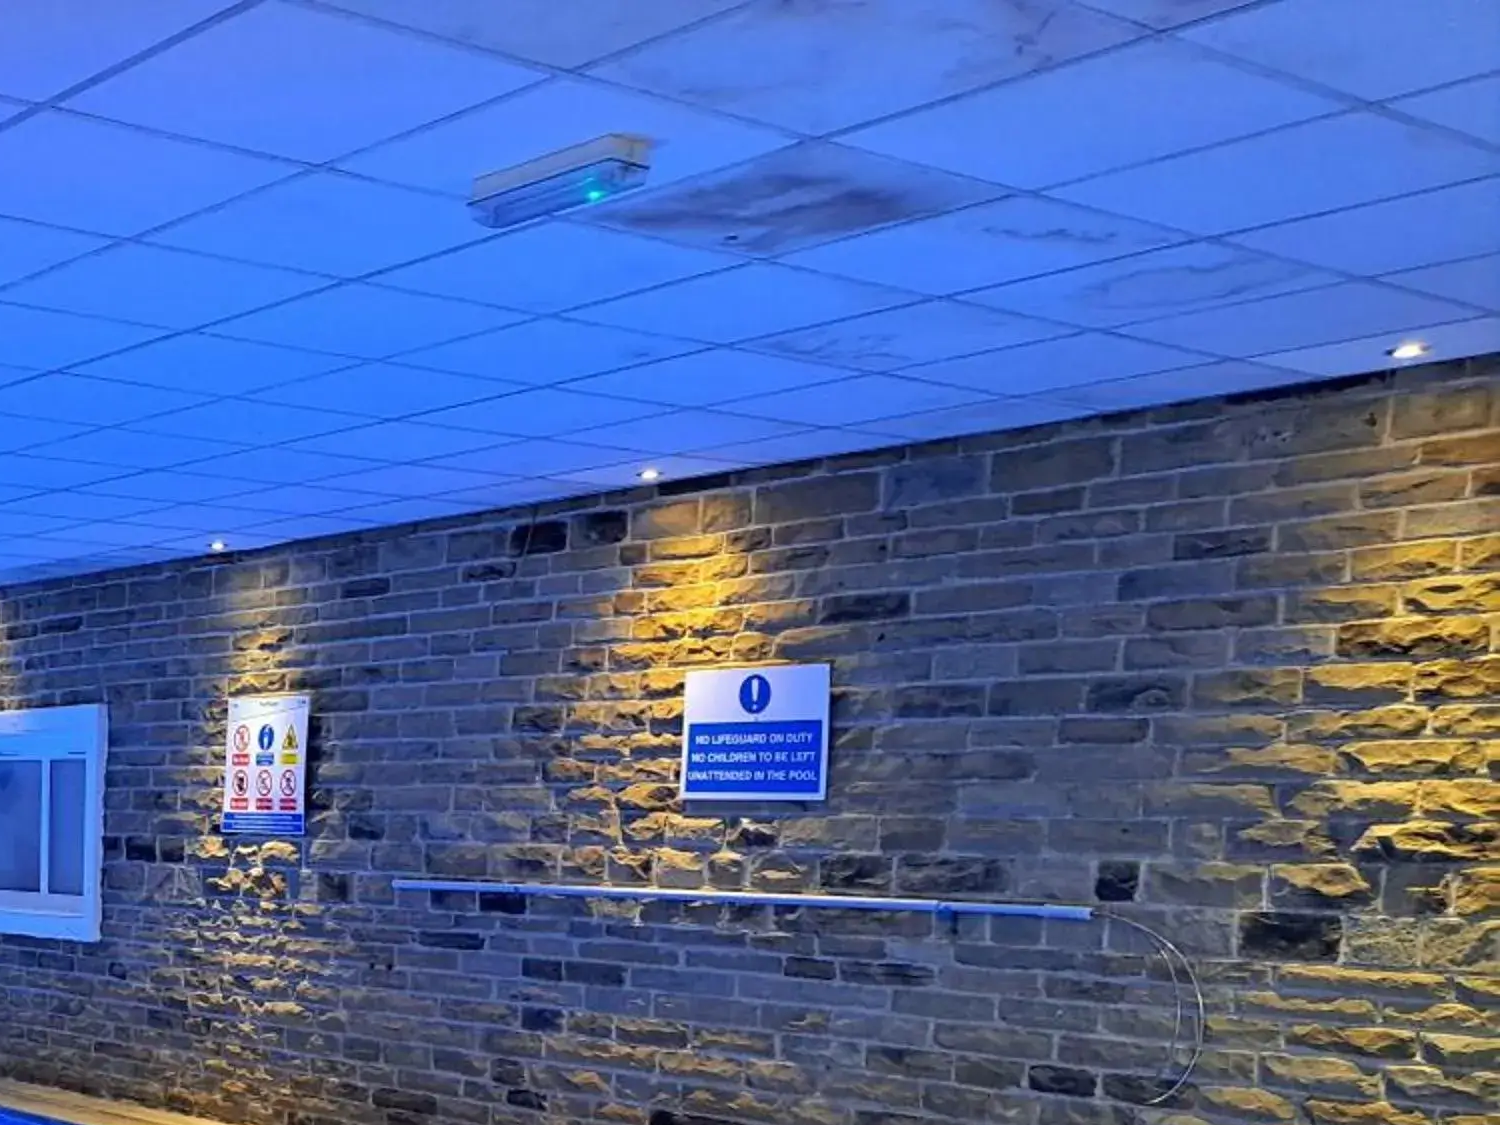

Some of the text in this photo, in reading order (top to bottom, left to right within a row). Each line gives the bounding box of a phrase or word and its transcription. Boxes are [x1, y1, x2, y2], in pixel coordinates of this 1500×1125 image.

[695, 732, 813, 745] NO LIFEGUARD ON DUTY
[691, 751, 816, 763] NO CHILDREN TO BE LEFT
[687, 770, 817, 781] UNATTENDED IN THE POOL
